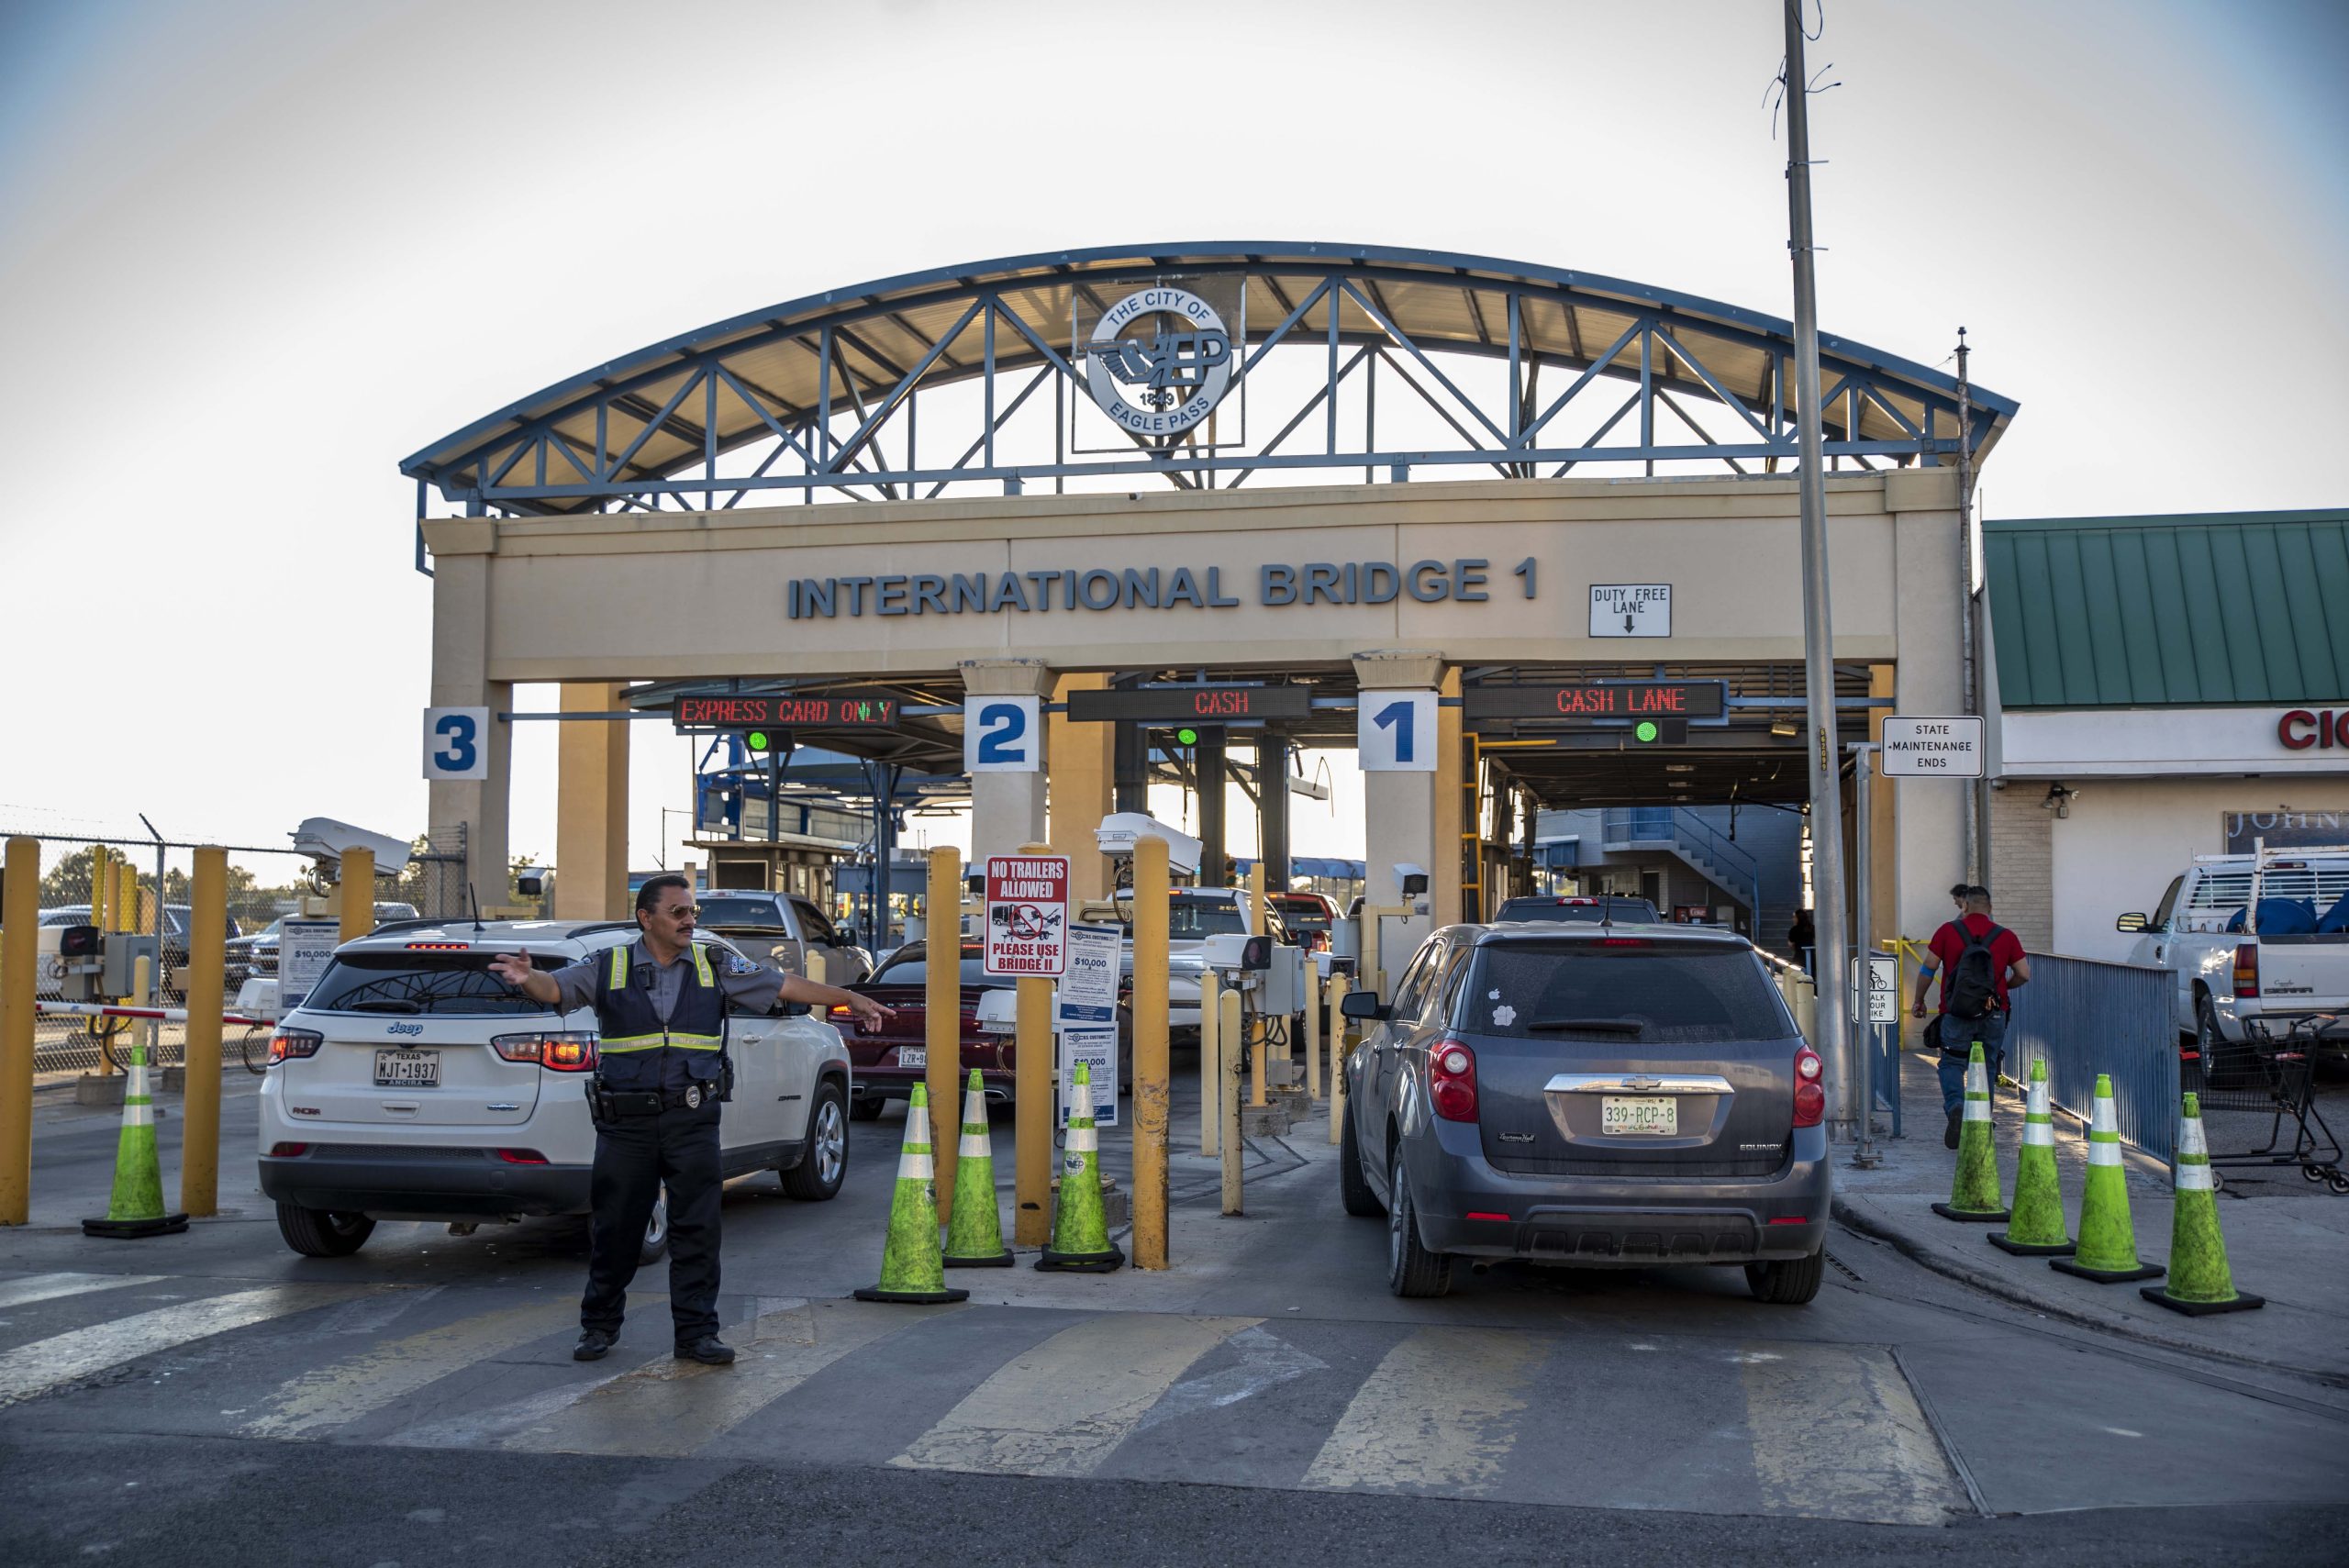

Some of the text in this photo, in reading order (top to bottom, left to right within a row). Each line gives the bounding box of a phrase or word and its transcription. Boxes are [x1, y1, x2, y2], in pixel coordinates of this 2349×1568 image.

[1108, 292, 1209, 325] THE CITY OF
[1140, 393, 1174, 406] 1849
[1109, 397, 1208, 430] EAGLE PASS
[788, 557, 1537, 618] INTERNATIONAL BRIDGE 1
[1595, 588, 1666, 601] DUTY FREE
[1613, 601, 1644, 614] LANE
[1195, 691, 1249, 714] CASH
[1557, 688, 1686, 712] CASH LANE
[681, 700, 892, 722] EXPRESS CARD ONLY
[978, 704, 1025, 763] 2
[1373, 701, 1414, 762] 1
[1915, 725, 1949, 734] STATE
[434, 715, 476, 772] 3
[1892, 741, 1972, 751] MAINTENANCE
[1917, 758, 1946, 767] ENDS
[991, 862, 1064, 879] NO TRAILERS
[1000, 881, 1053, 898] ALLOWED
[295, 951, 331, 959] $10,000
[993, 943, 1033, 956] PLEASE
[1037, 944, 1059, 956] USE
[997, 958, 1052, 970] BRIDGE II
[1074, 957, 1107, 968] $10,000
[387, 1021, 424, 1036] Jeep
[1606, 1106, 1675, 1123] 339-RCP-8
